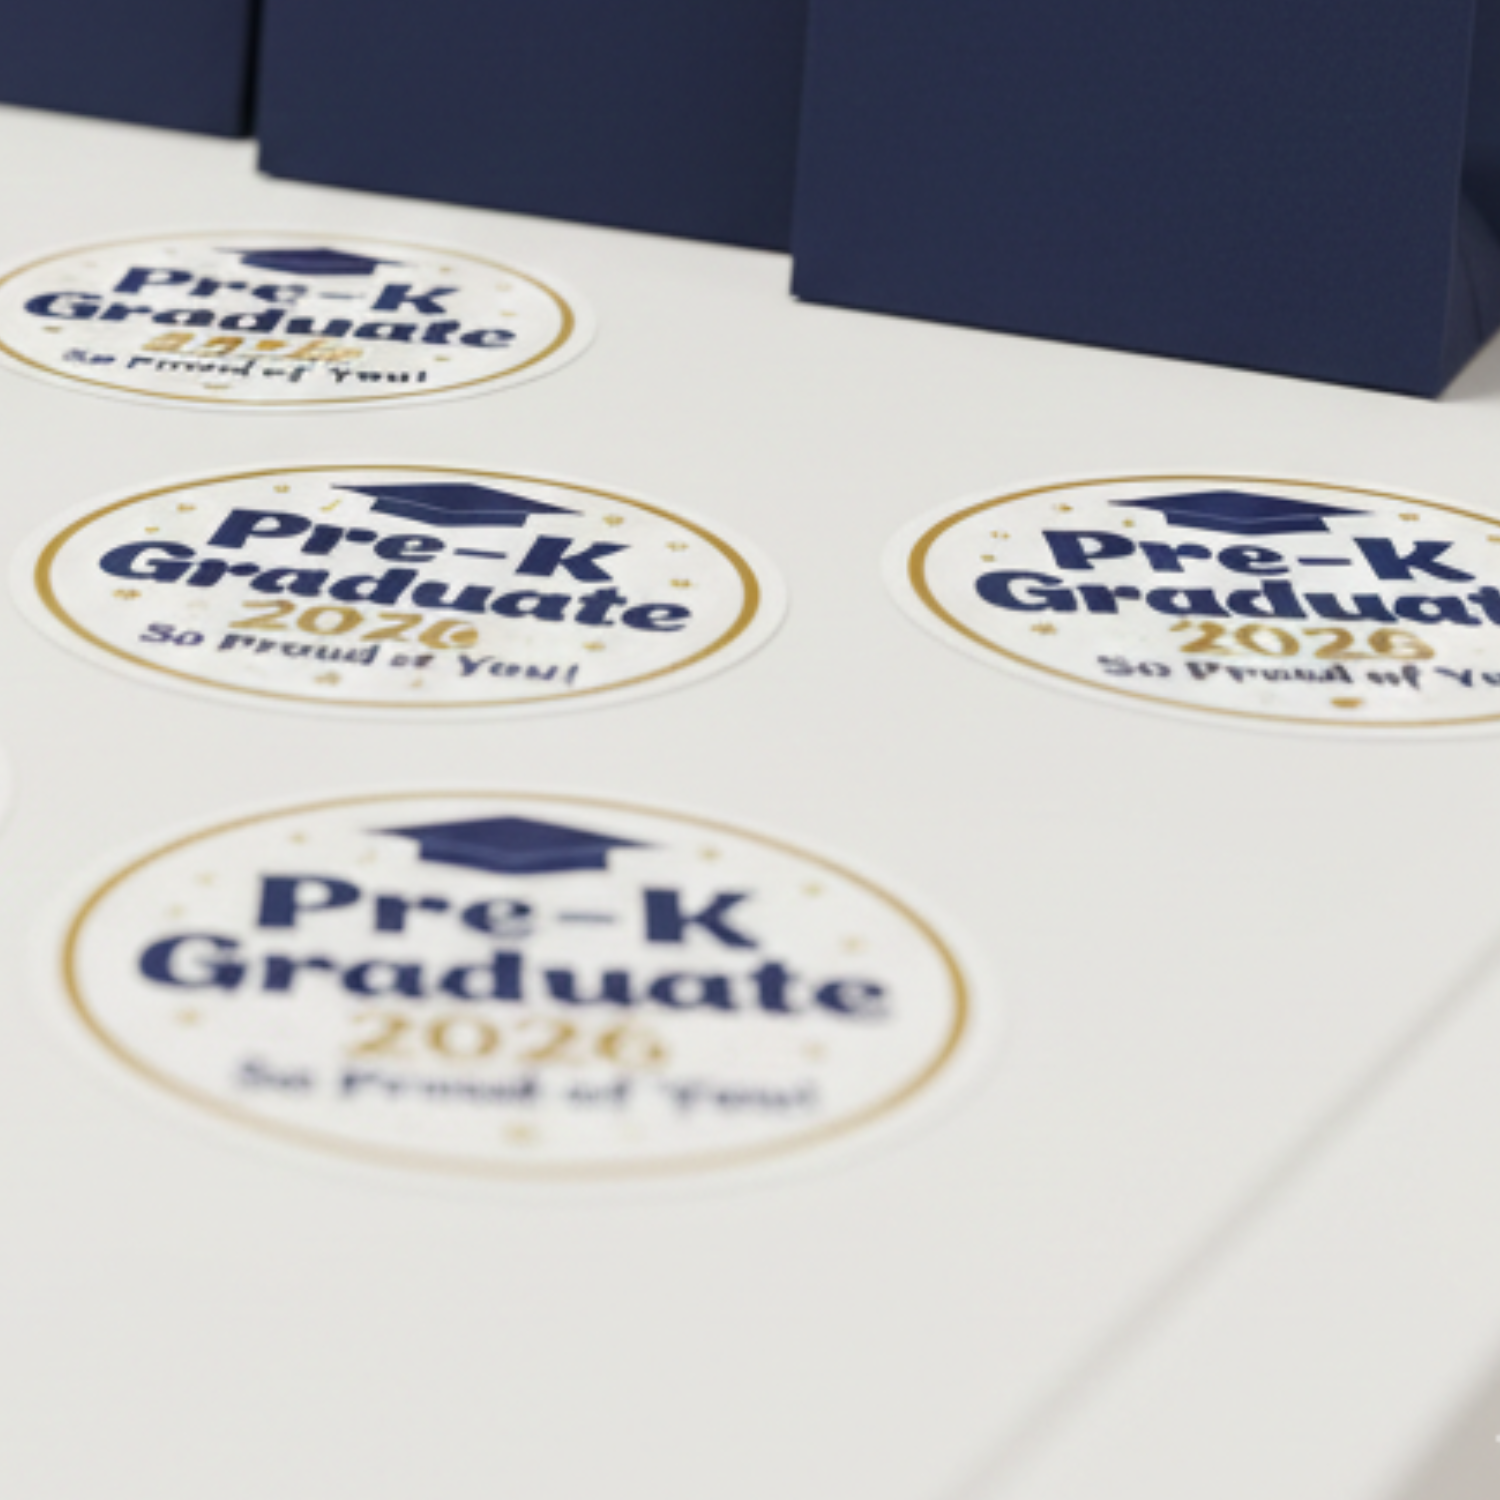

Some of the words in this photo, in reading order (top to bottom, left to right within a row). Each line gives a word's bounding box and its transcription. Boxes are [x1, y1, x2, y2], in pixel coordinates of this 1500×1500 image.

[24, 291, 516, 349] Graduate
[112, 266, 461, 315] Pre-K
[206, 508, 633, 583] Pre-K
[1041, 529, 1475, 584] Pre-K
[100, 539, 693, 633] Graduate
[140, 622, 203, 647] So
[457, 653, 579, 684] You!
[255, 872, 765, 952] Pre-K
[136, 931, 892, 1018] Graduate
[345, 1012, 670, 1069] 2026
